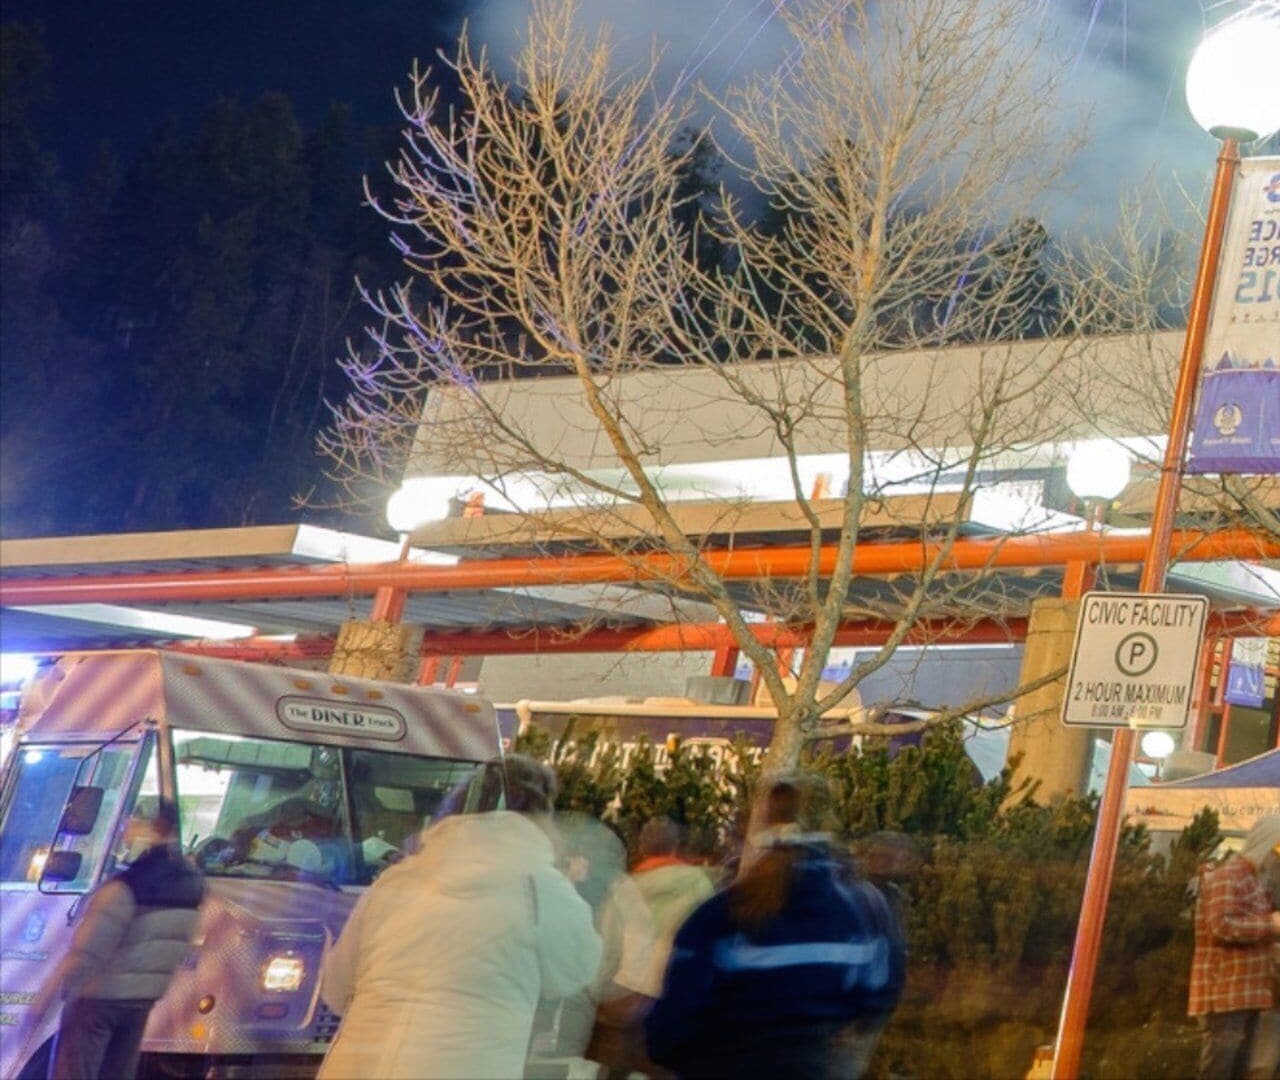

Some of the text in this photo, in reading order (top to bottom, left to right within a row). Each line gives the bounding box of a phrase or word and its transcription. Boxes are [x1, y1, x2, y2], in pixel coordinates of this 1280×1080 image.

[1088, 601, 1197, 628] CIVIC FACILITY
[1129, 642, 1146, 666] P
[1074, 682, 1187, 705] 2 HOUR MAXIMUM
[311, 708, 365, 726] DINER
